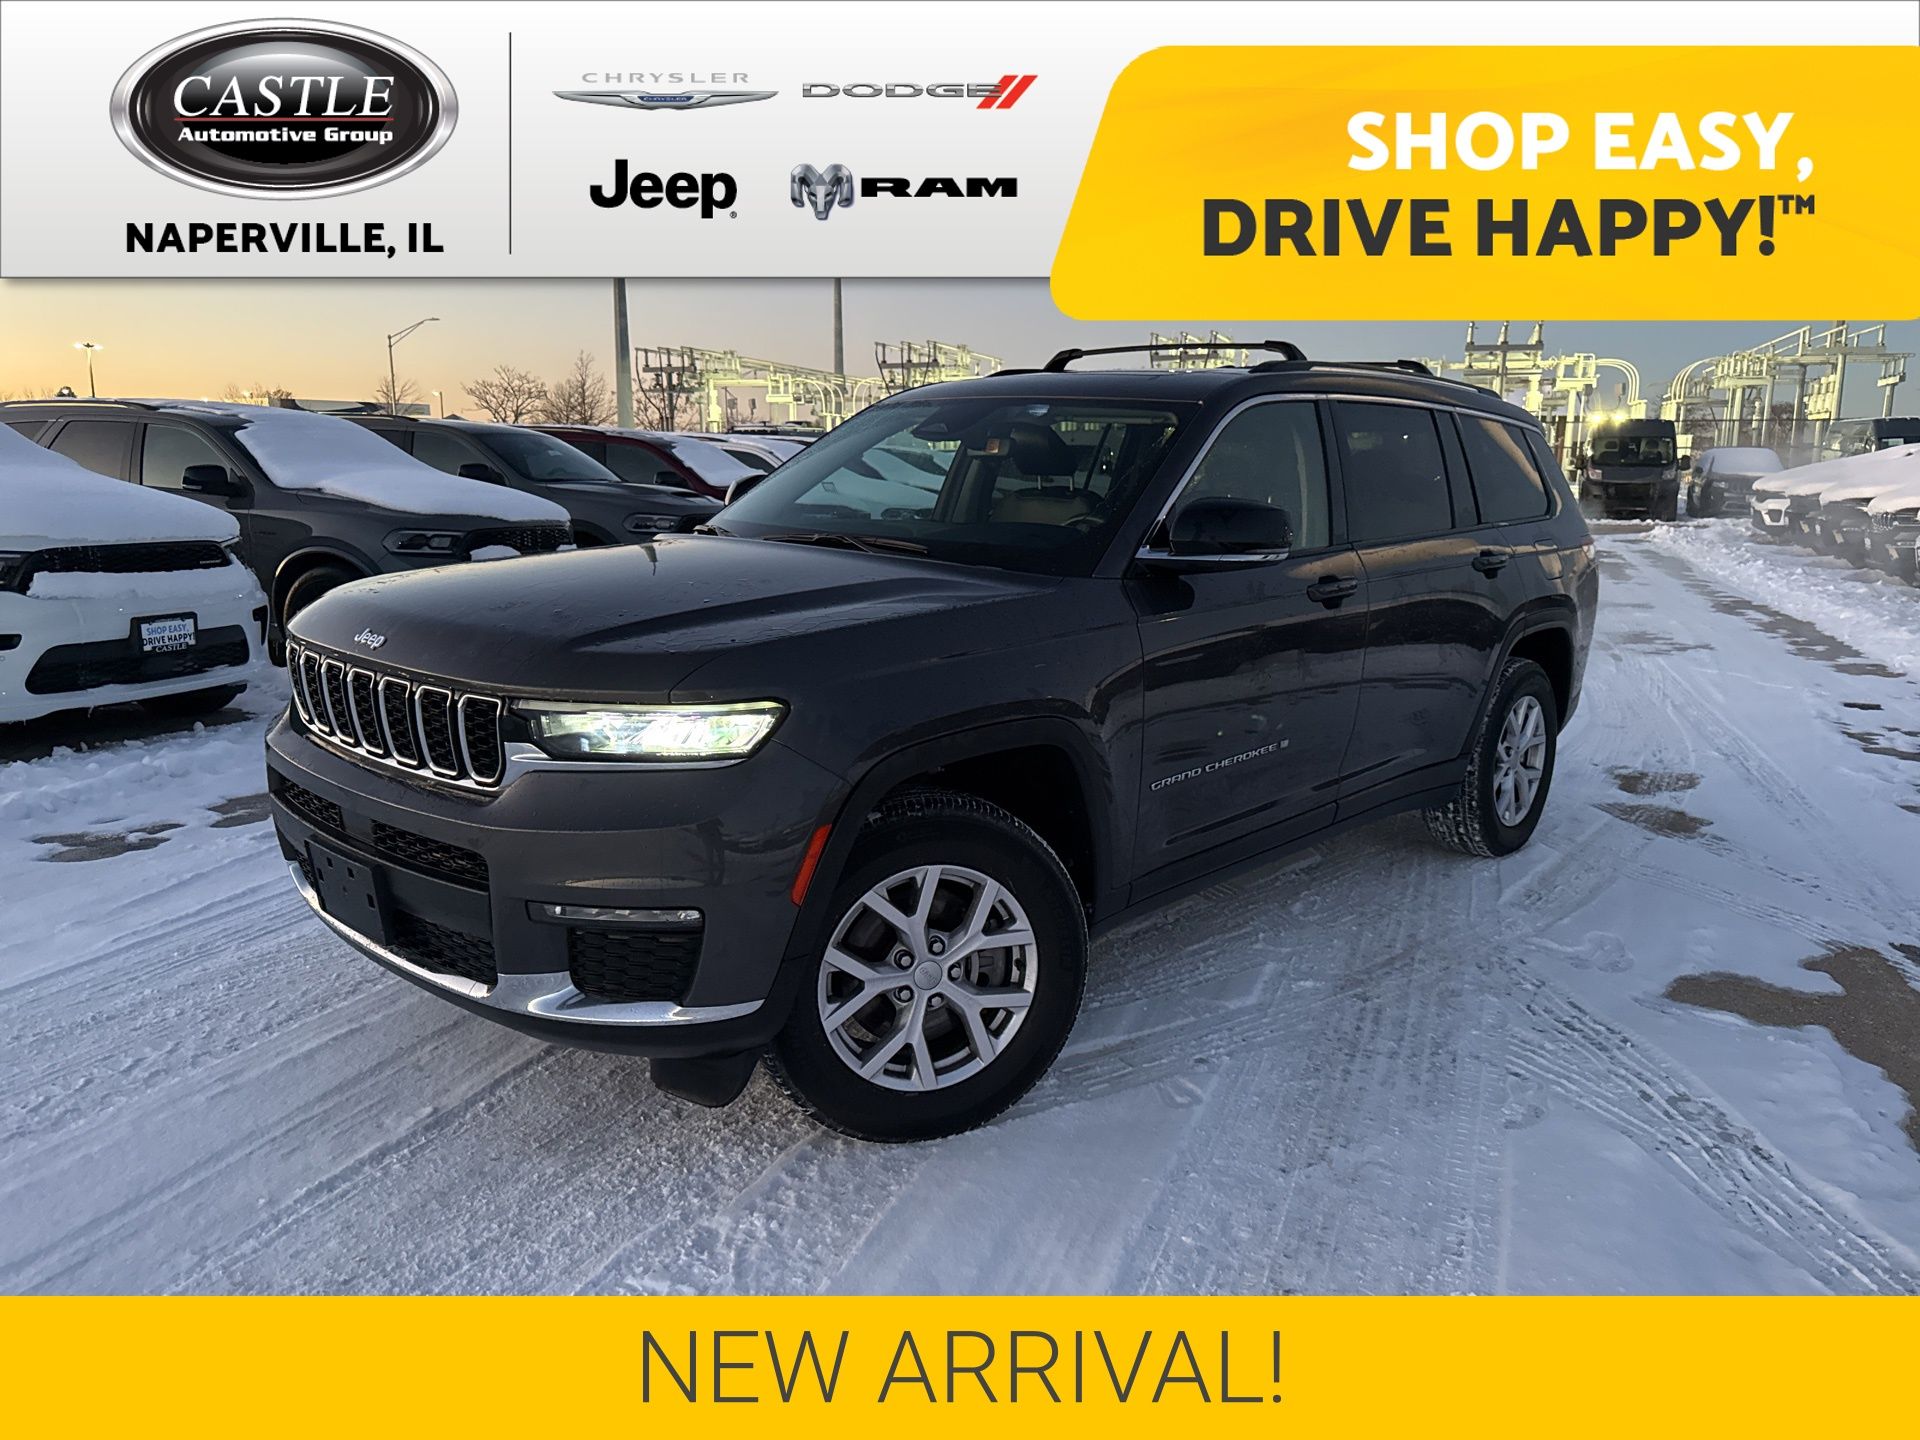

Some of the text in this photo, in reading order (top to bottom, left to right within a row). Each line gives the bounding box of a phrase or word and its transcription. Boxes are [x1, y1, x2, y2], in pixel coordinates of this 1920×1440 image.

[146, 627, 167, 636] SHOP
[143, 635, 166, 646] DRIVE
[354, 628, 386, 649] Jeep
[155, 643, 187, 652] CASTLE
[1151, 743, 1277, 791] GRAND CHEROKEE
